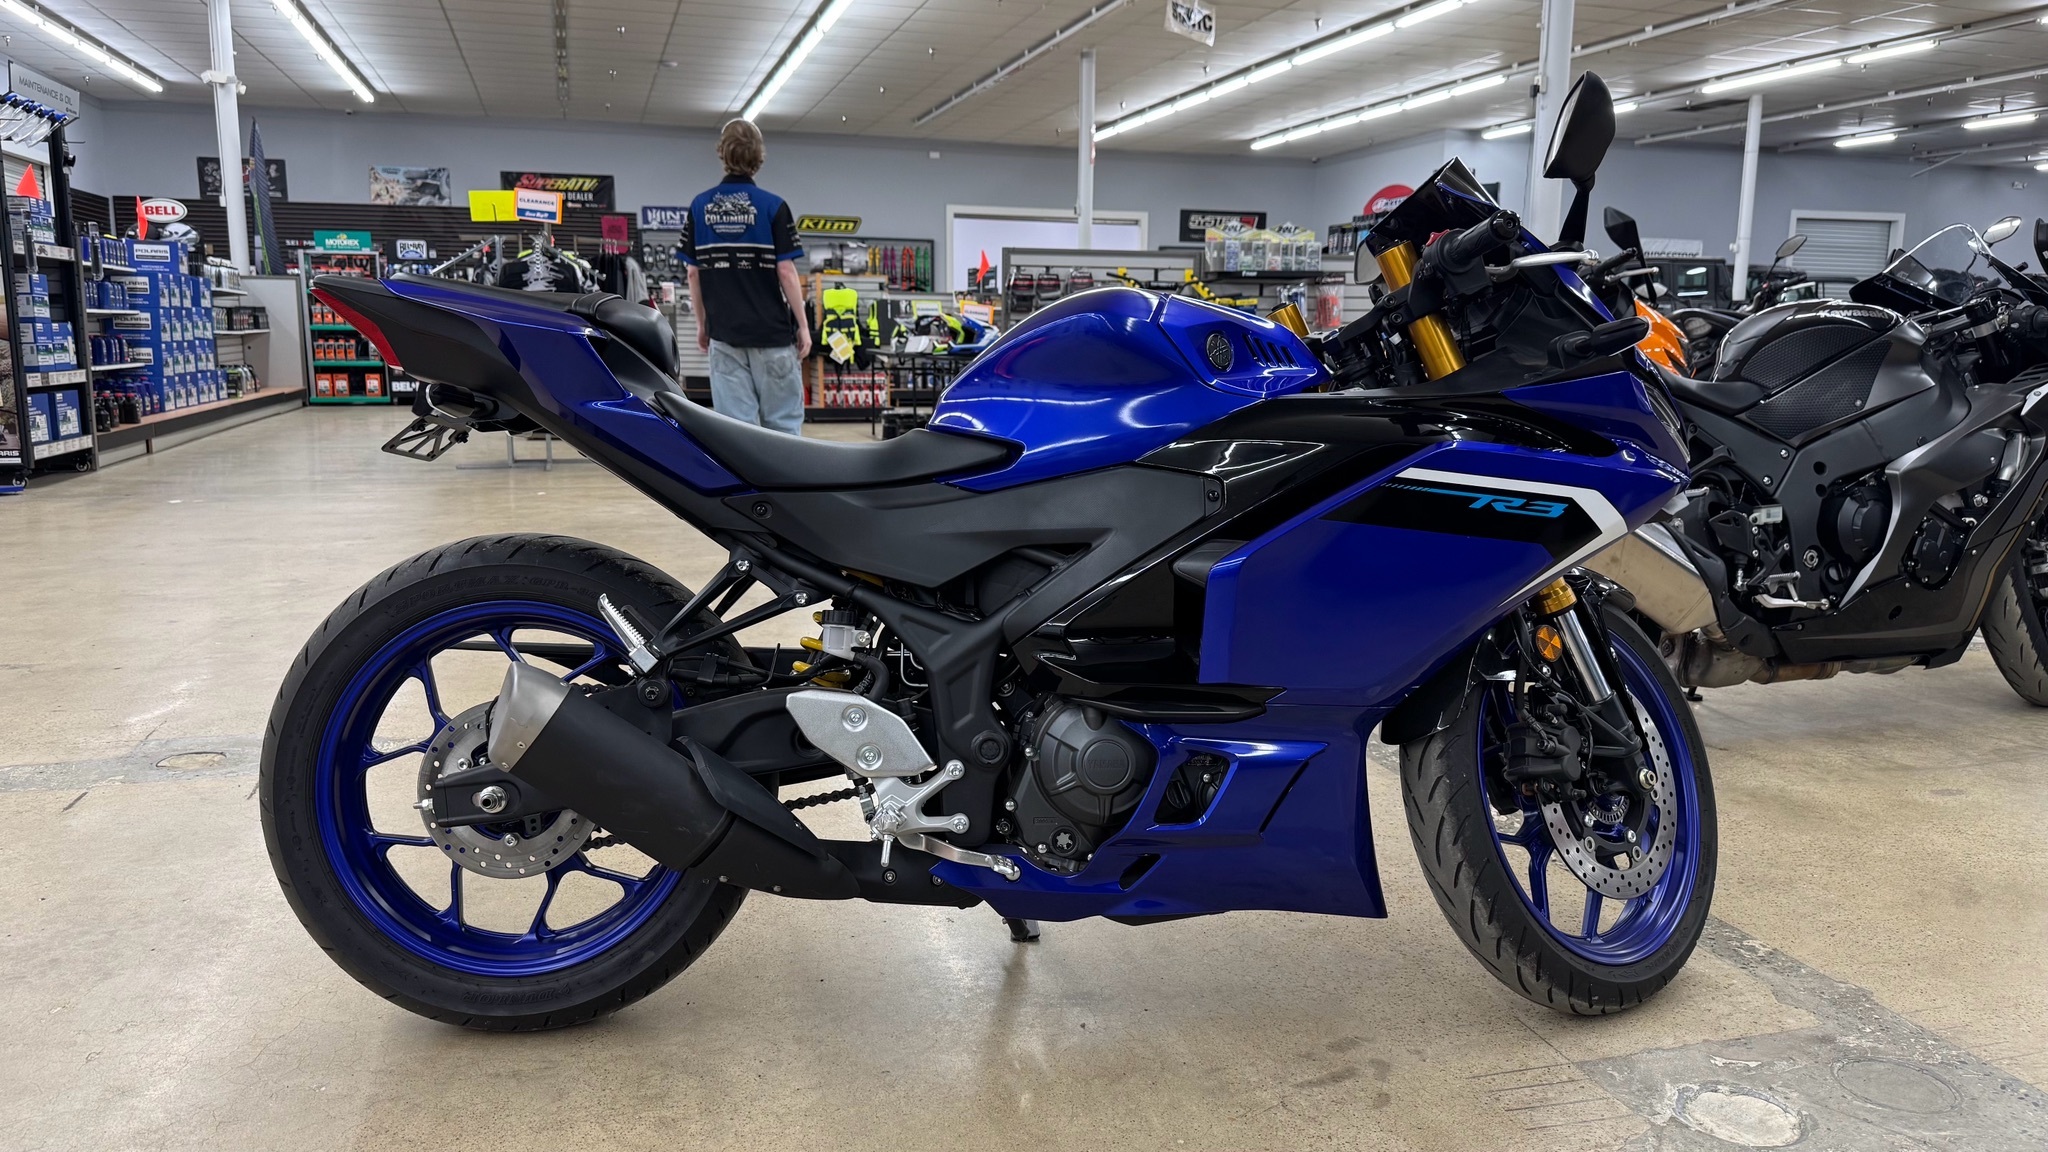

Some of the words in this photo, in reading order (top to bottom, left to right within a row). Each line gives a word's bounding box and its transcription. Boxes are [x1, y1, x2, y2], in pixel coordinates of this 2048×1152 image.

[18, 75, 59, 100] MAINTENANCE
[64, 95, 73, 106] OIL
[519, 197, 555, 206] CLEARANCE
[567, 191, 594, 202] DEALER
[144, 205, 179, 216] BELL
[704, 213, 755, 226] COLUMBIA
[325, 238, 360, 247] MOTOREX
[1819, 309, 1889, 319] Kawasaki
